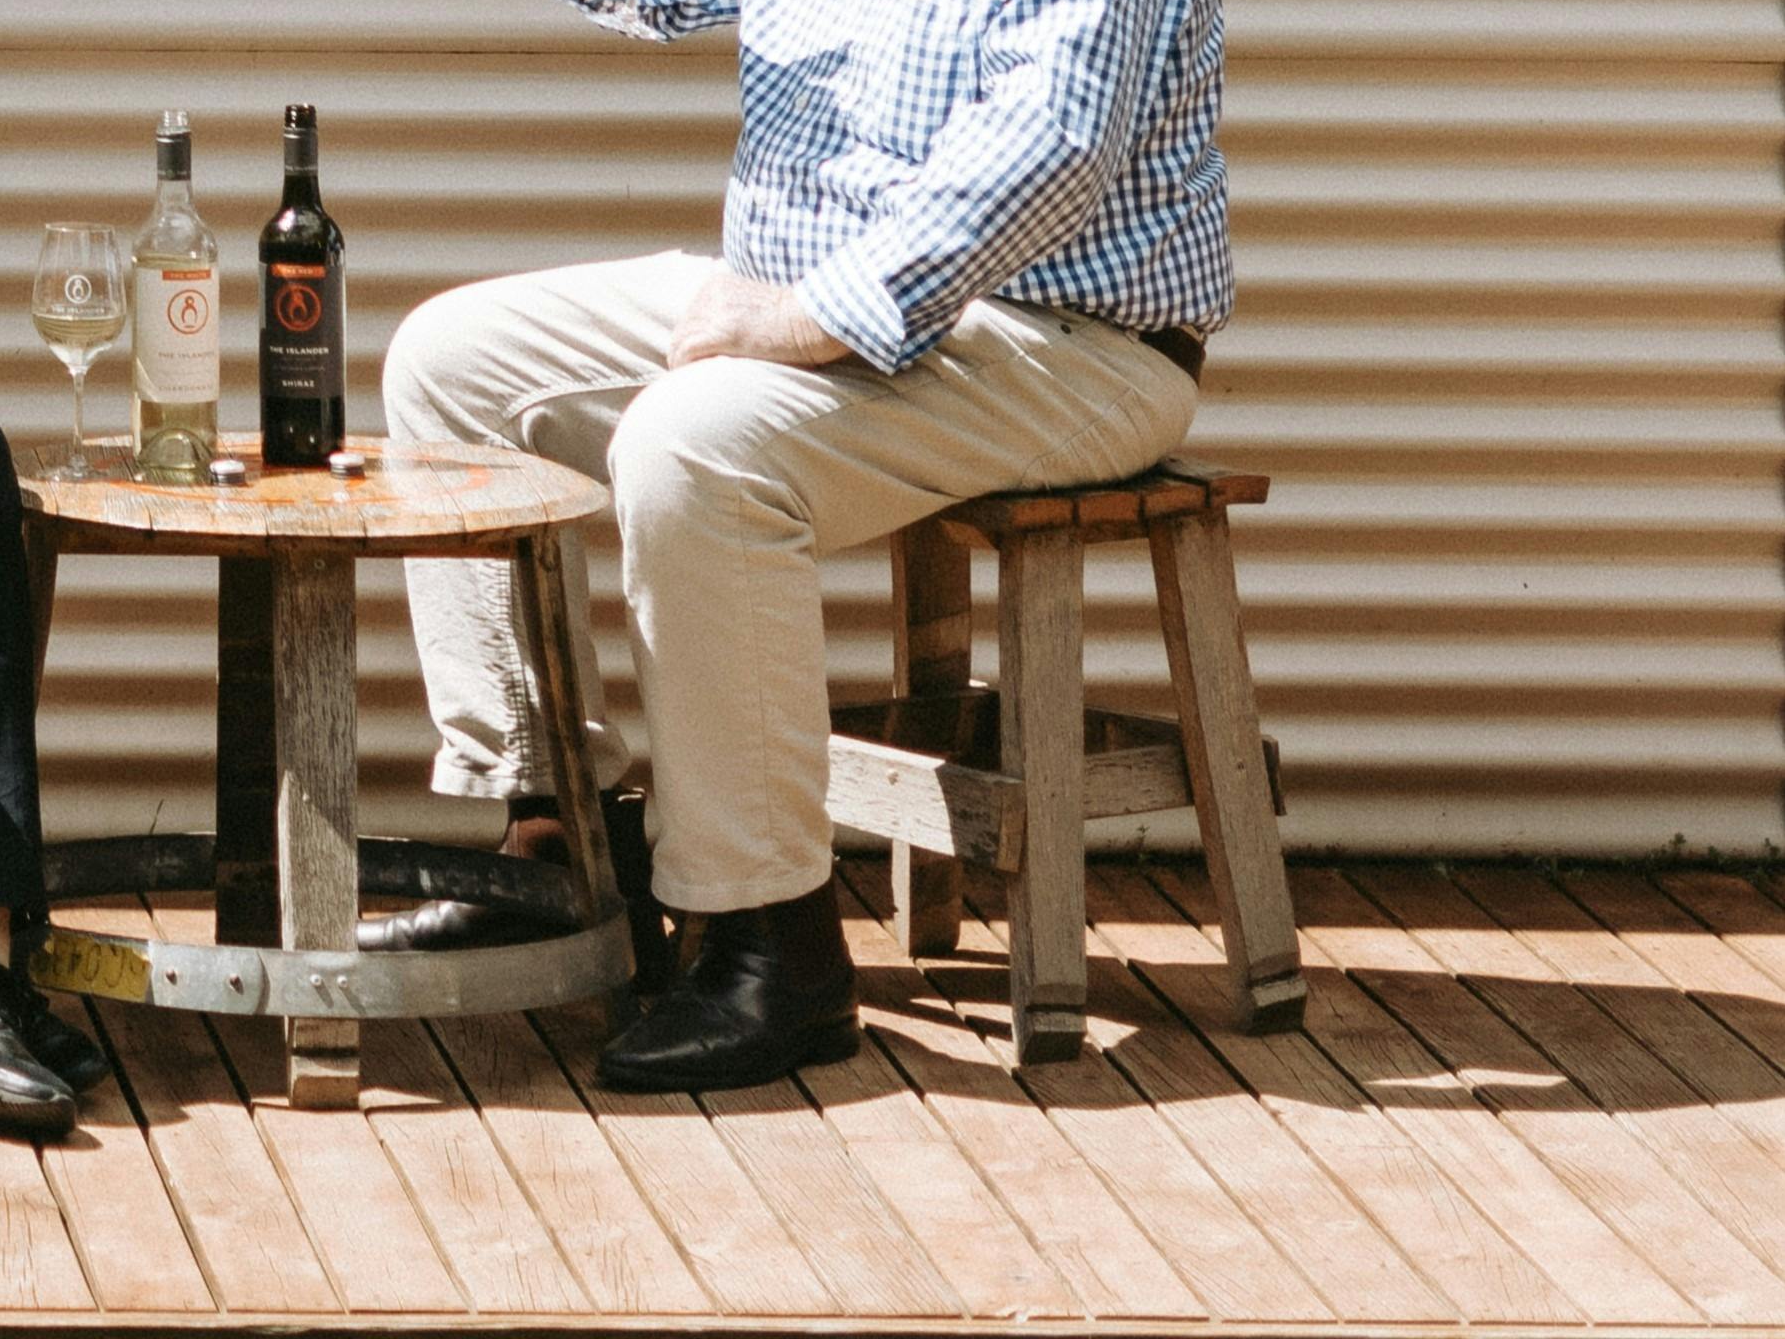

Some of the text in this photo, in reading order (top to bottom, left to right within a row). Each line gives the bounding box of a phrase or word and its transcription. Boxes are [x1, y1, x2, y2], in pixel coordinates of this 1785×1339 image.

[270, 345, 329, 355] THE ISLANDER
[282, 379, 314, 388] SHIRAZ
